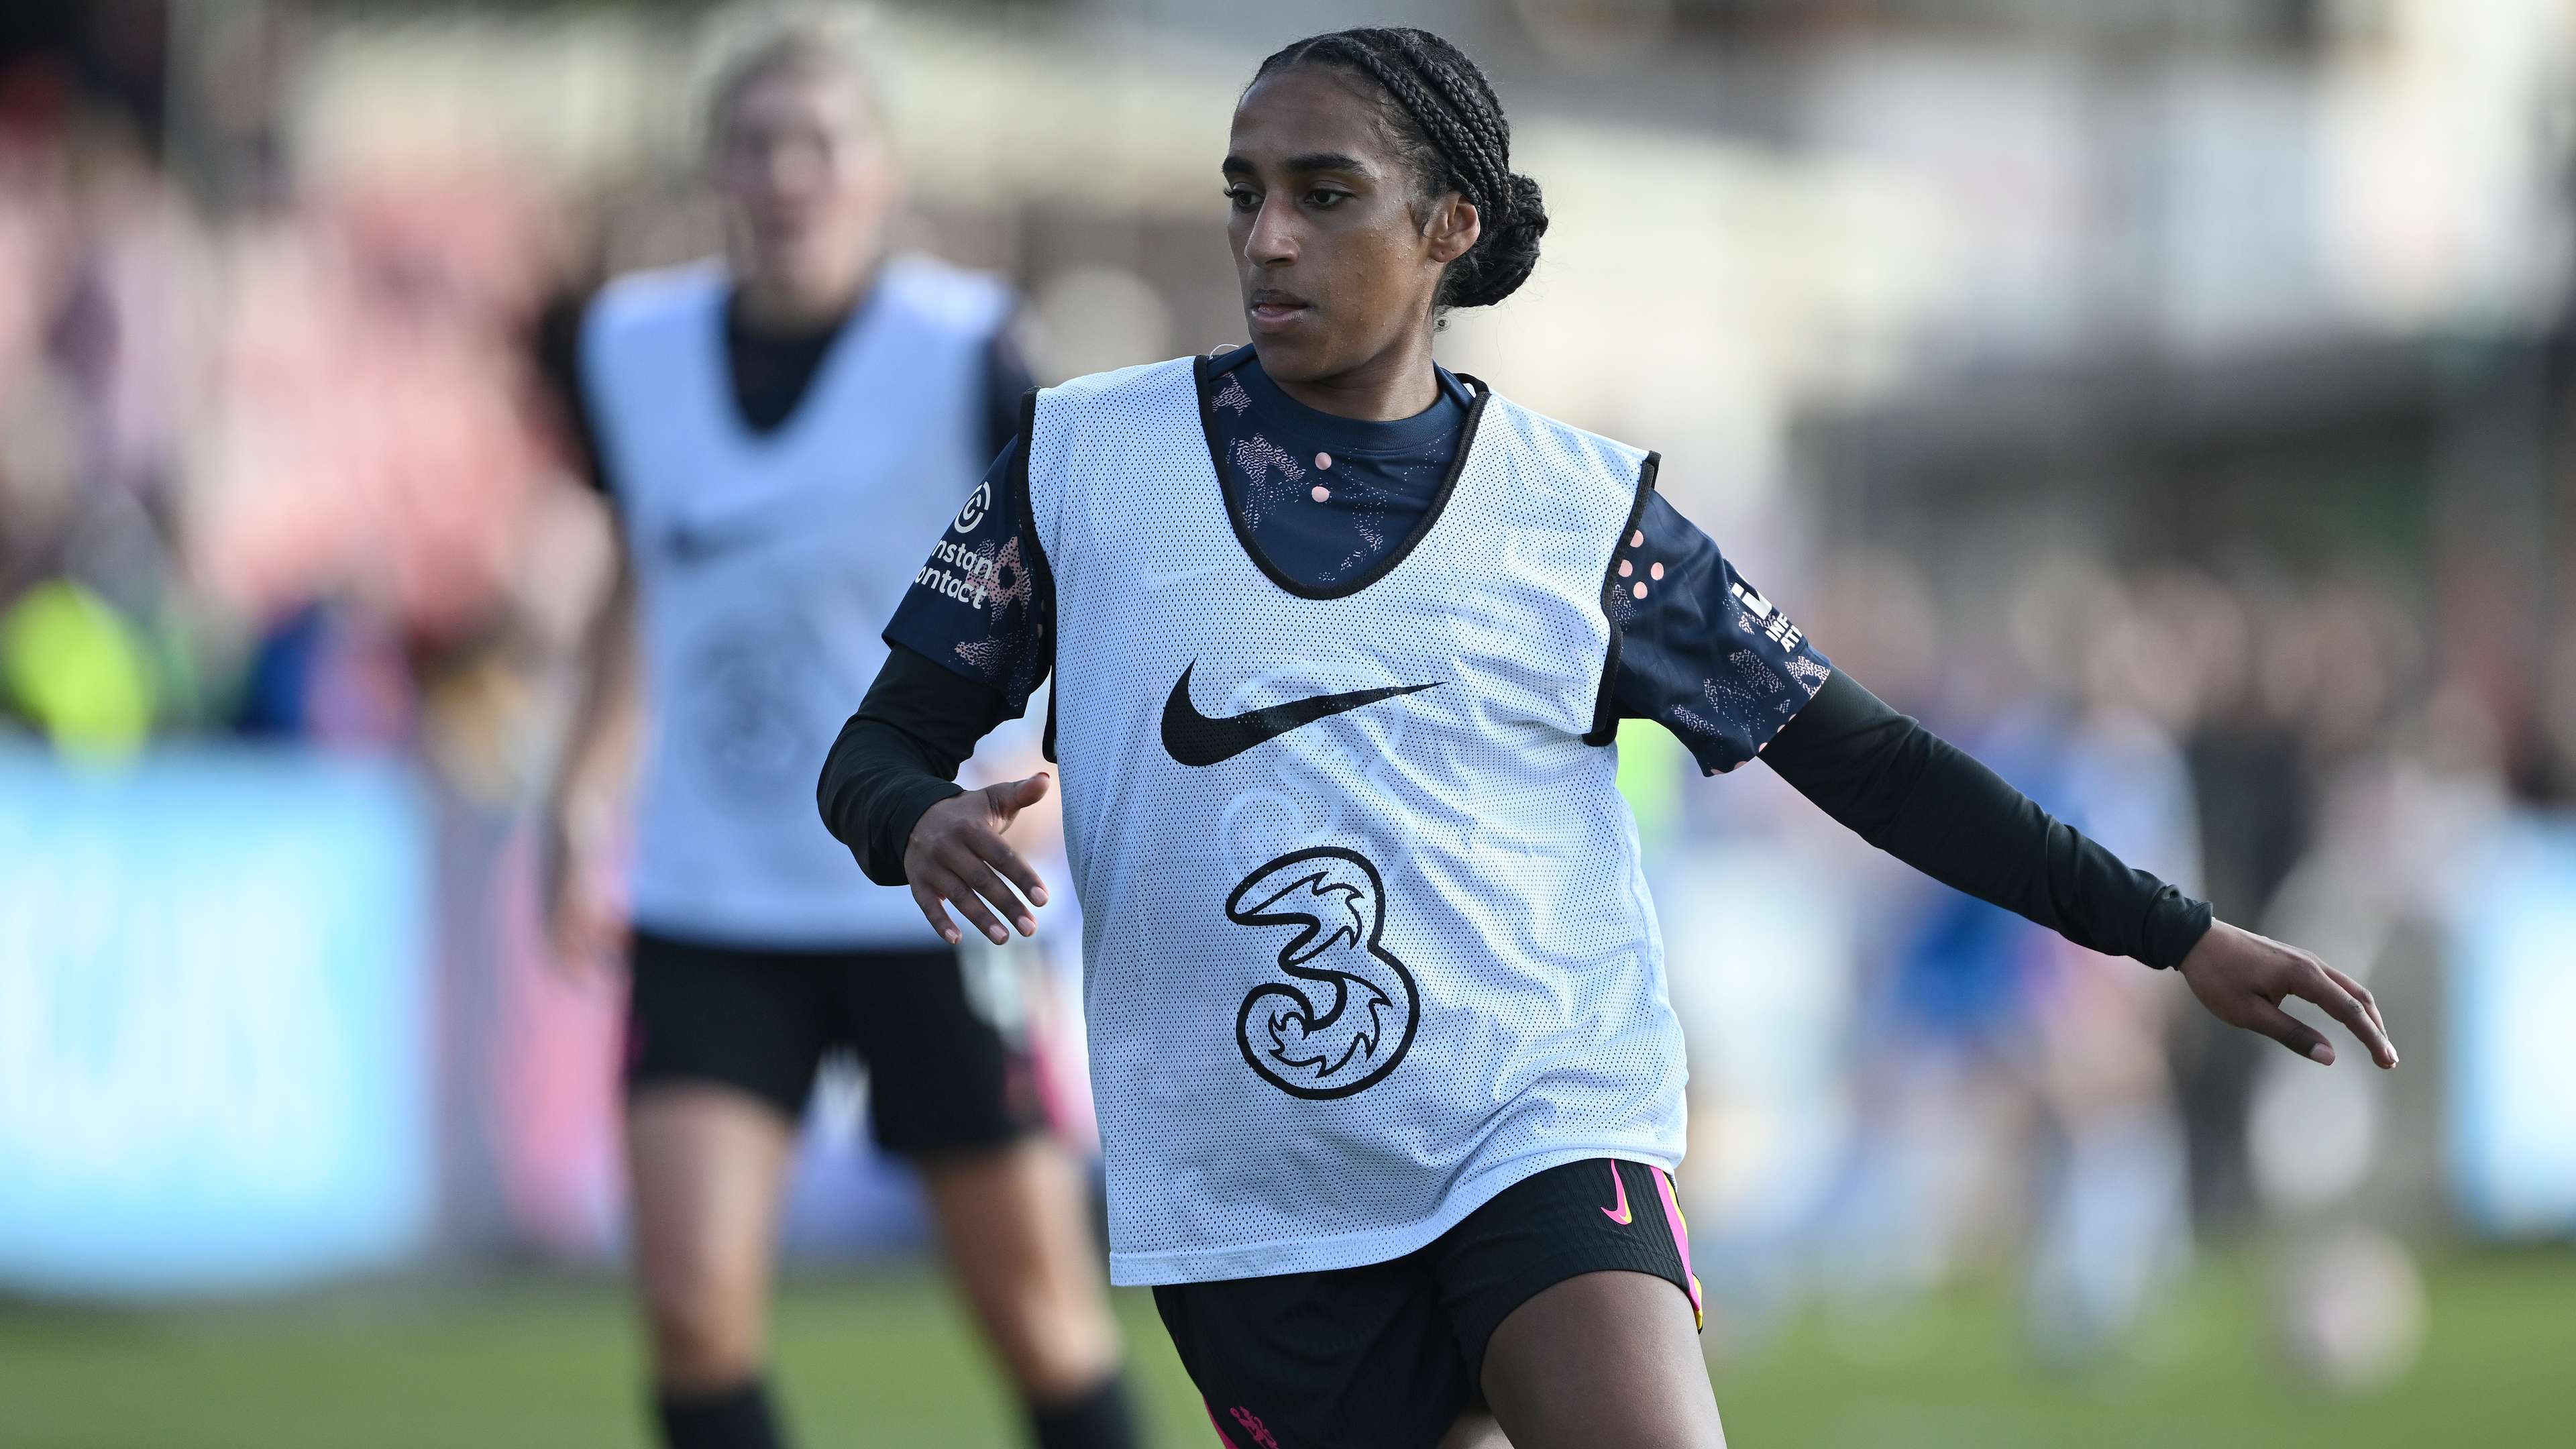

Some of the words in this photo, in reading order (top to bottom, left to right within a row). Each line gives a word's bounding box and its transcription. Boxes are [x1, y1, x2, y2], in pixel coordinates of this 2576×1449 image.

[932, 539, 993, 580] nstan
[915, 566, 987, 609] ontact
[1765, 612, 1789, 642] INF
[1226, 846, 1420, 1101] 3
